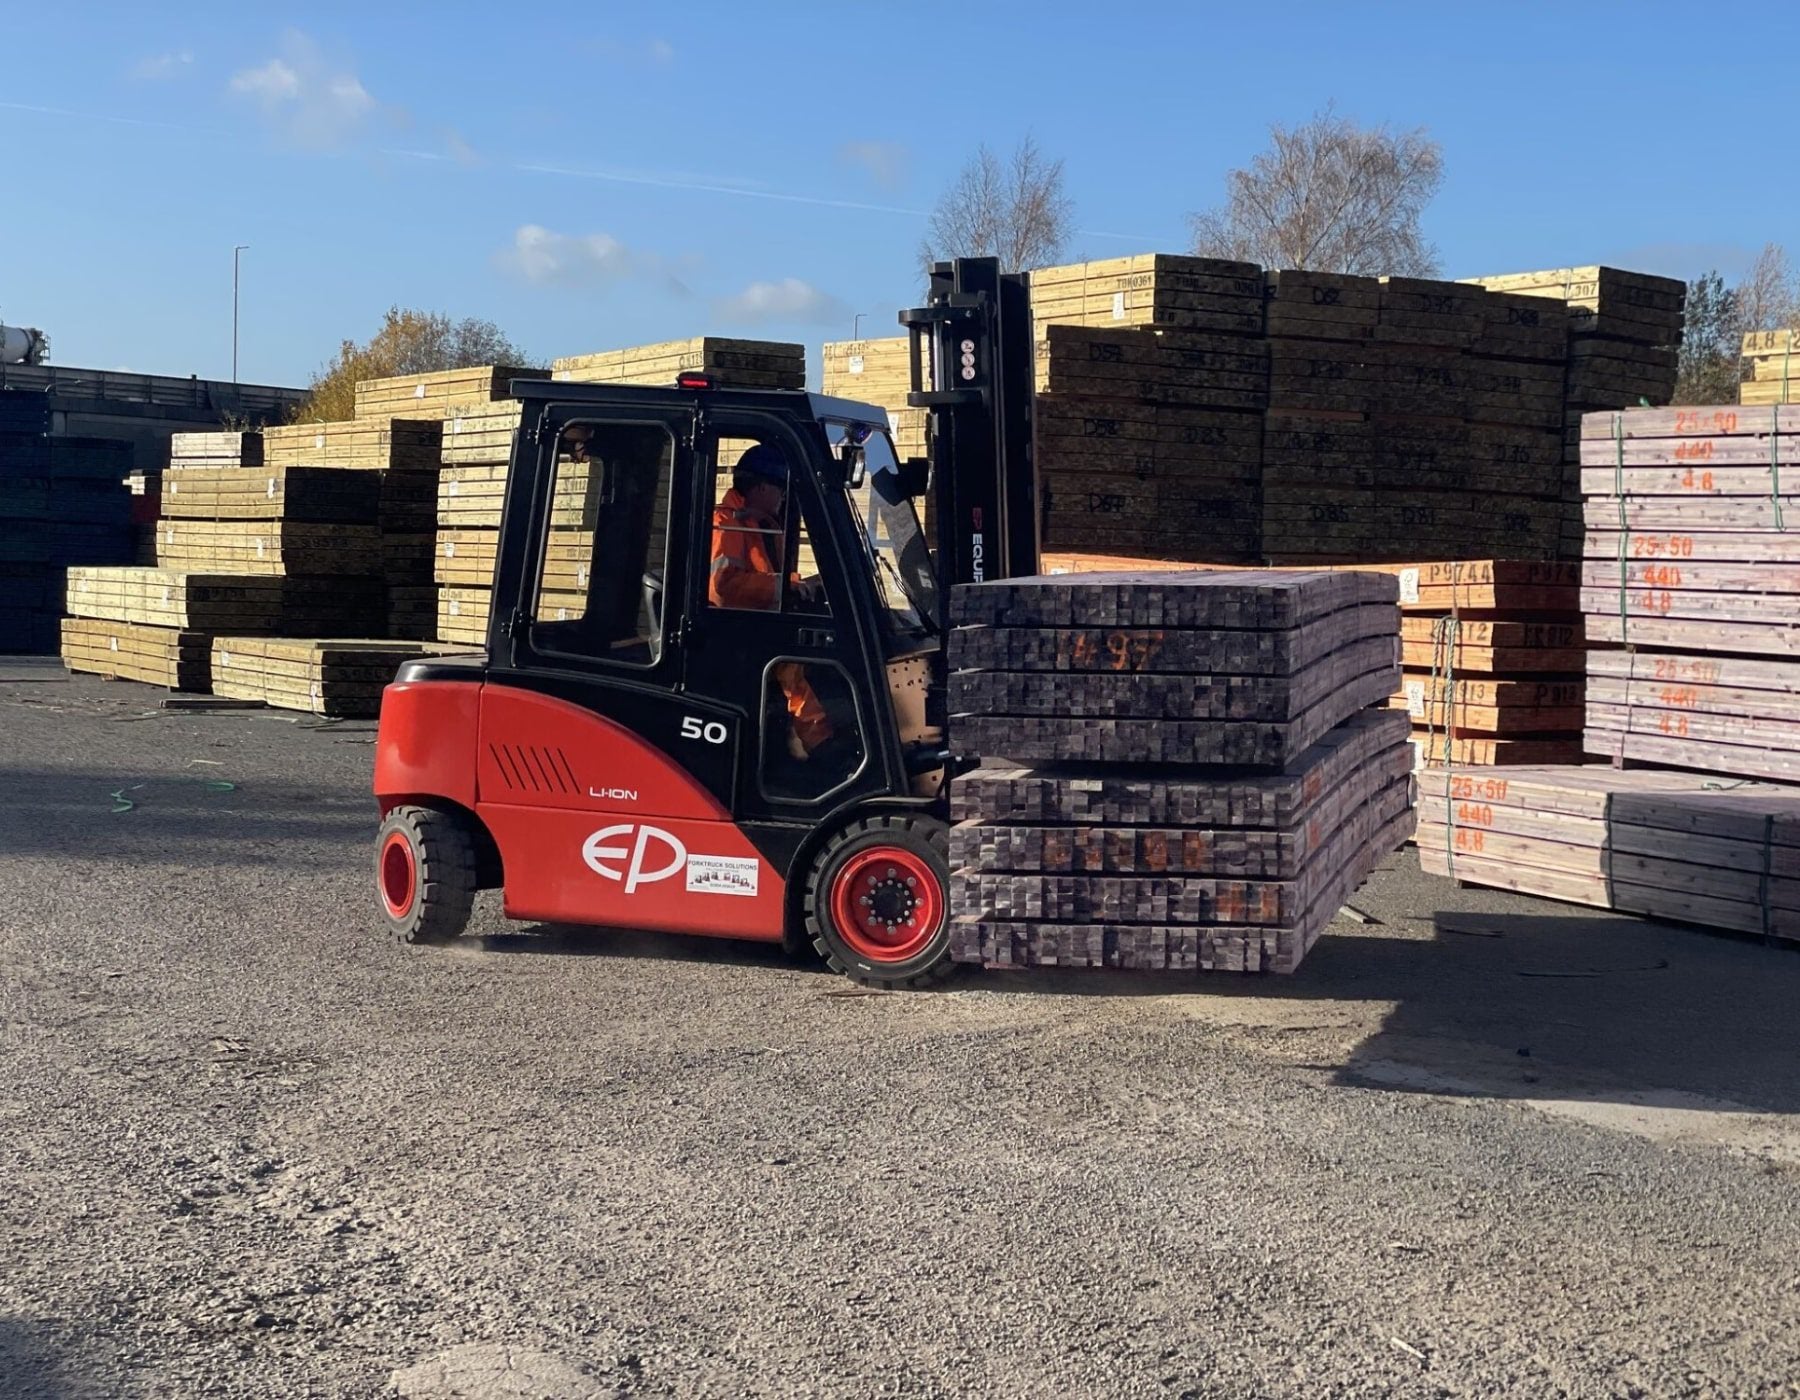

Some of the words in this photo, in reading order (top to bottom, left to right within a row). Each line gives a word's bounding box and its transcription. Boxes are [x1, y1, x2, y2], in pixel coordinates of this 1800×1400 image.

[1746, 332, 1775, 351] 4.8
[1644, 564, 1681, 585] 440
[680, 716, 727, 744] 50
[589, 787, 638, 801] LI-ION
[1458, 803, 1493, 826] 440
[1455, 829, 1484, 852] 4.8
[582, 824, 687, 894] EP
[688, 860, 724, 868] FORKTRUCK
[724, 862, 757, 871] SOLUTIONS
